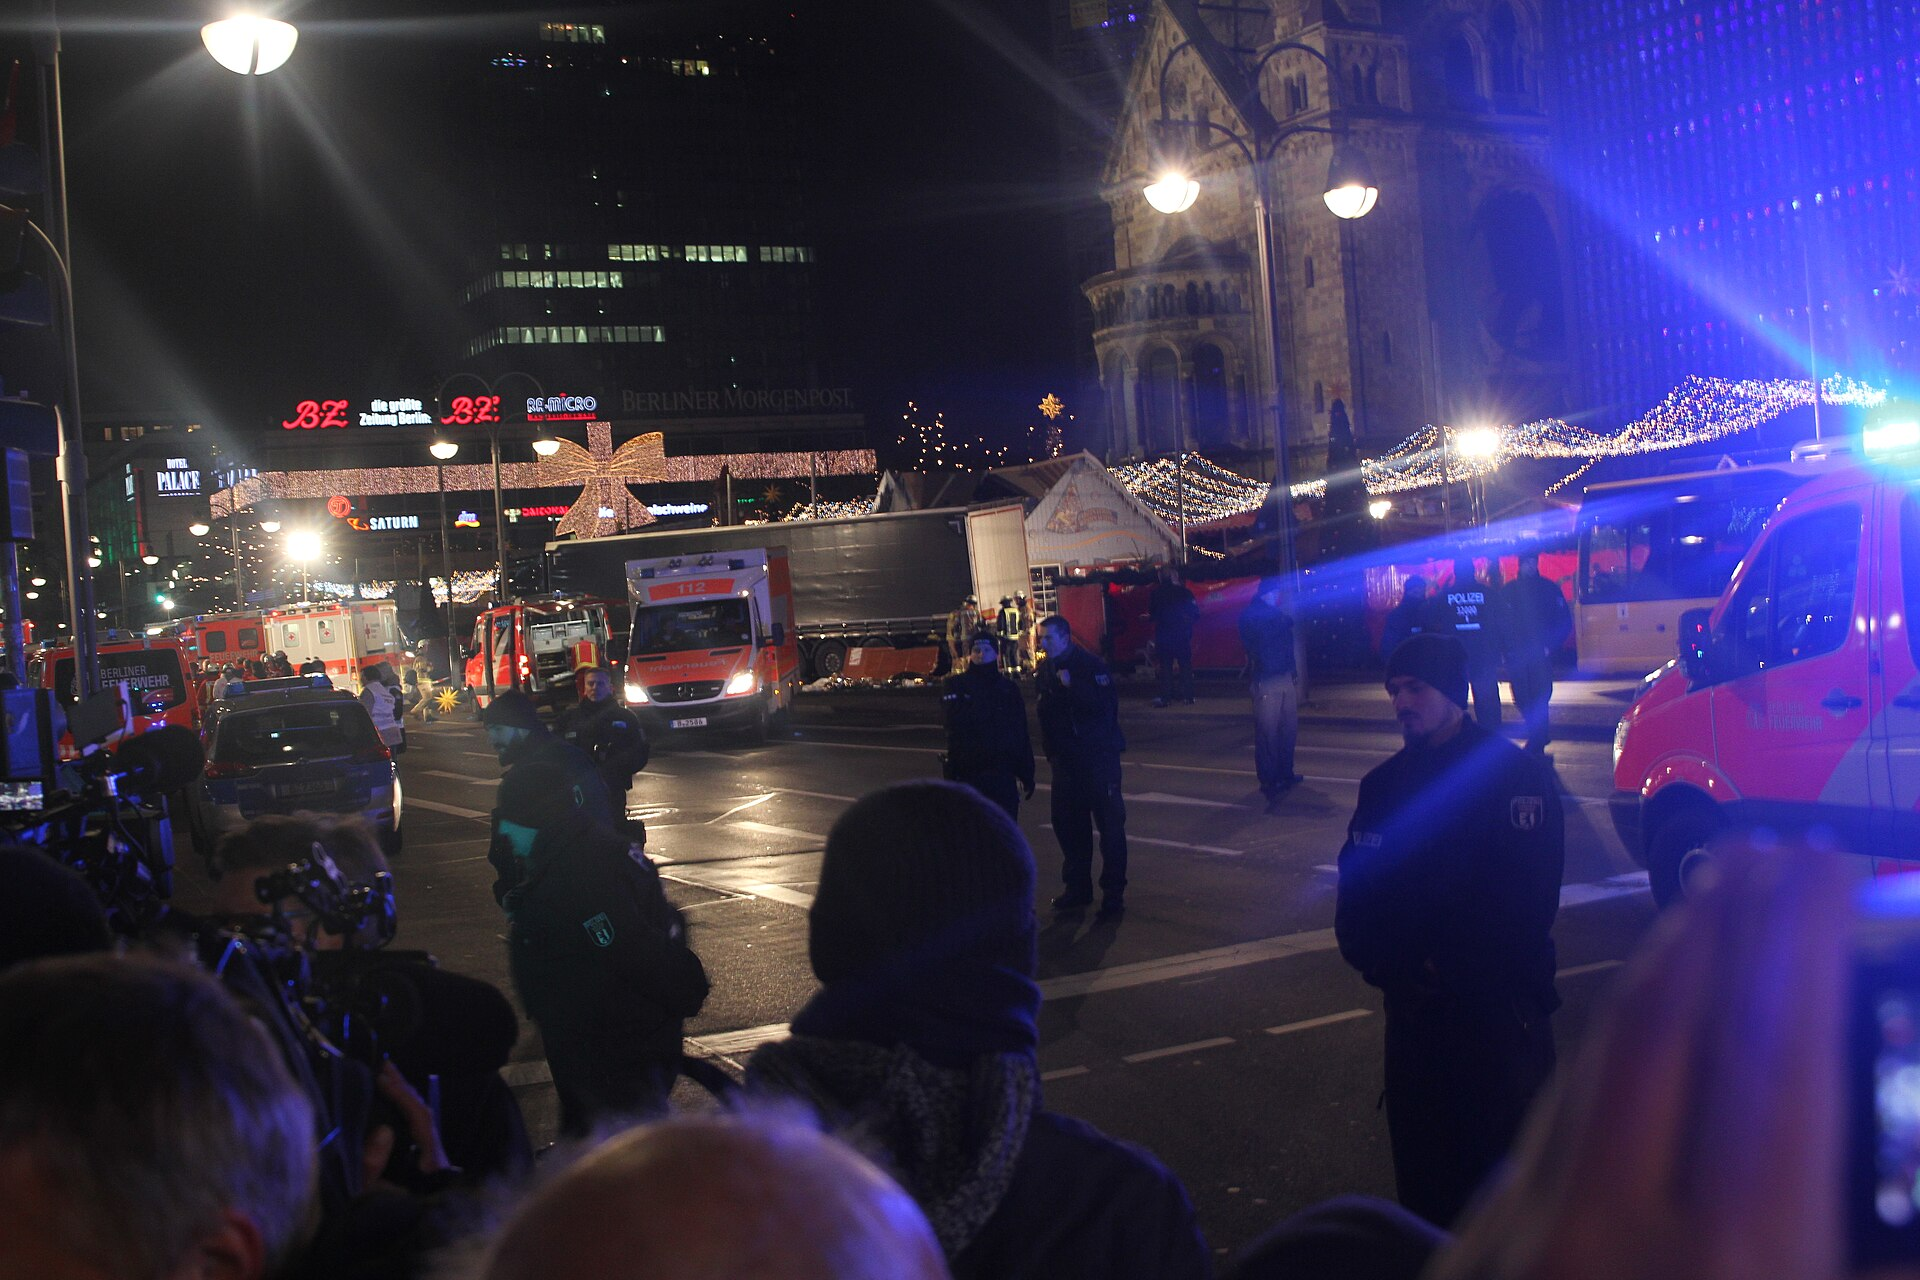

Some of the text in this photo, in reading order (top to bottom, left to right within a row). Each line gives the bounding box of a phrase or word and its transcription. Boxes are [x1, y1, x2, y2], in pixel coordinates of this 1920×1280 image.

[371, 399, 388, 412] die
[621, 387, 853, 412] BERLINER MORGENPOST
[359, 412, 398, 426] Zeitung
[166, 458, 188, 469] HOTEL
[156, 470, 201, 491] PALACE
[369, 515, 419, 530] SATURN
[677, 582, 706, 594] 112
[1447, 592, 1485, 606] POLIZEI
[101, 665, 147, 679] BERLINER
